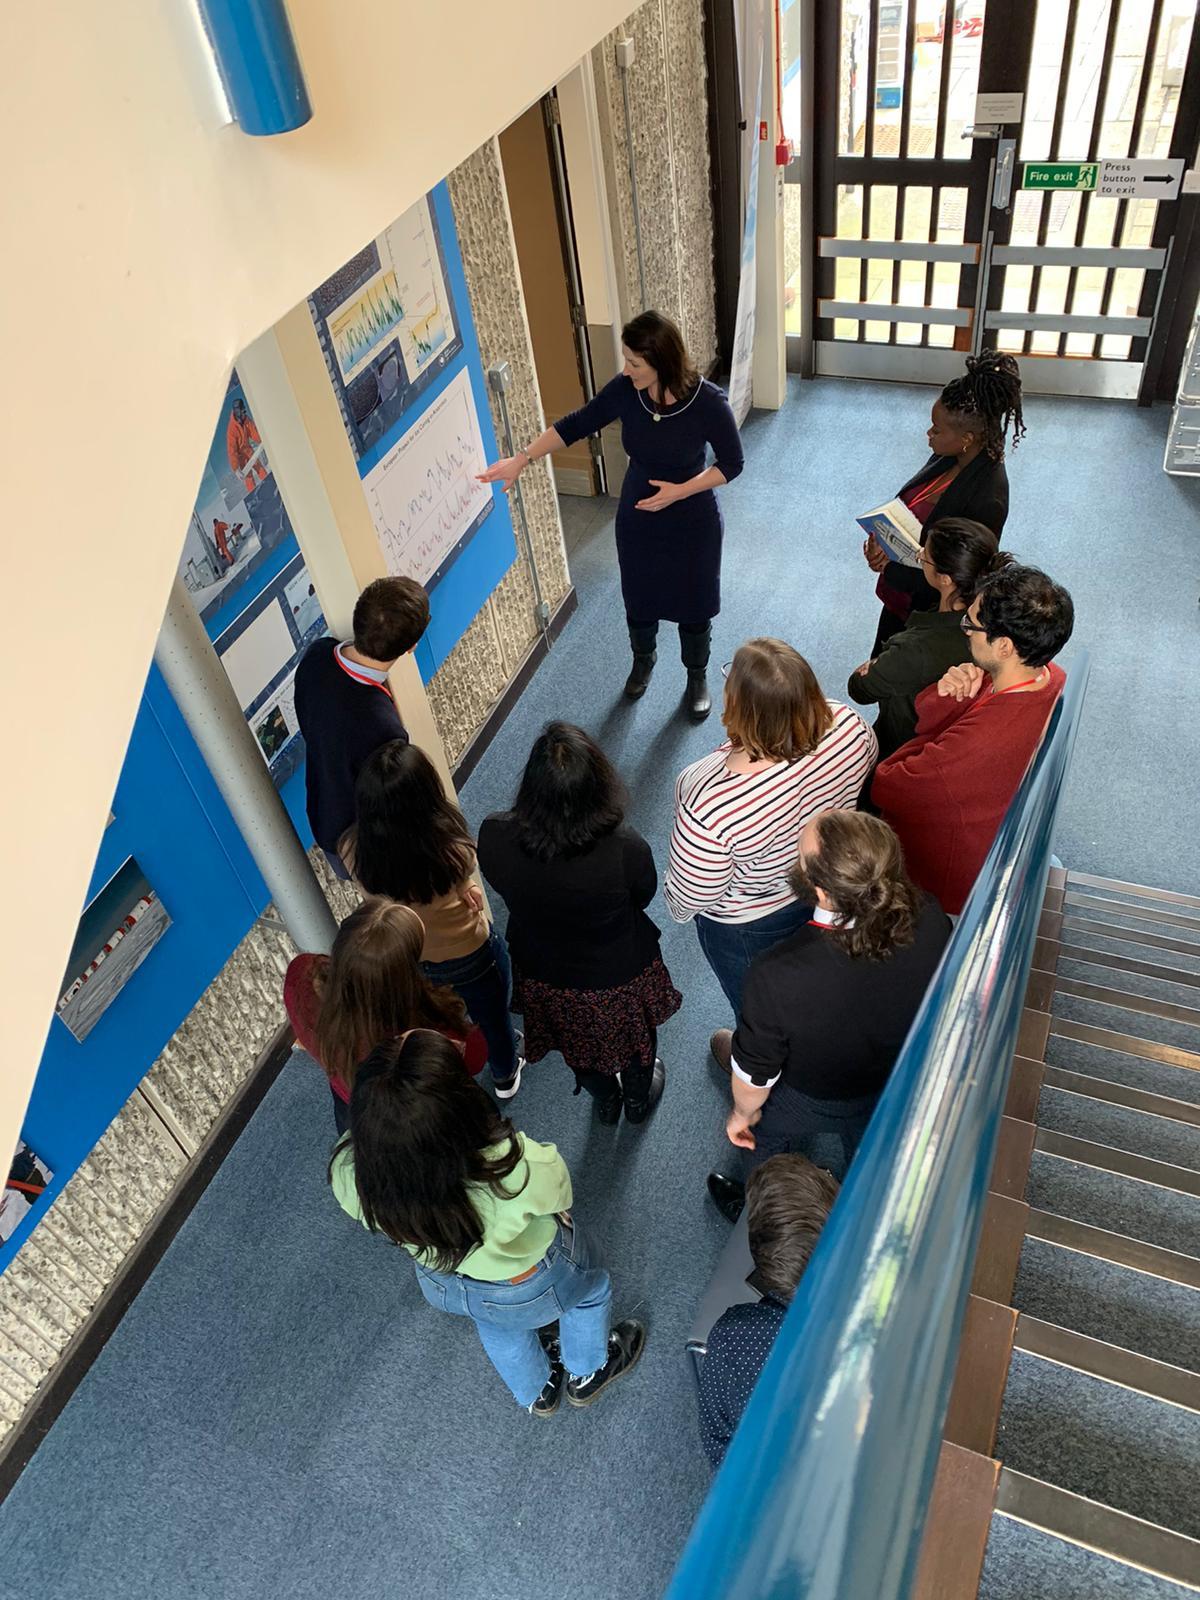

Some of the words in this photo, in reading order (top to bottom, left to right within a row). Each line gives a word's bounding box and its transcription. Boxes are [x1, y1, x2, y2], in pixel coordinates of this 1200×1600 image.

[1104, 162, 1132, 172] Press
[1029, 171, 1050, 181] Fire
[1053, 171, 1074, 182] exit
[1102, 174, 1137, 183] button
[1101, 186, 1113, 194] to
[1115, 185, 1136, 194] exit
